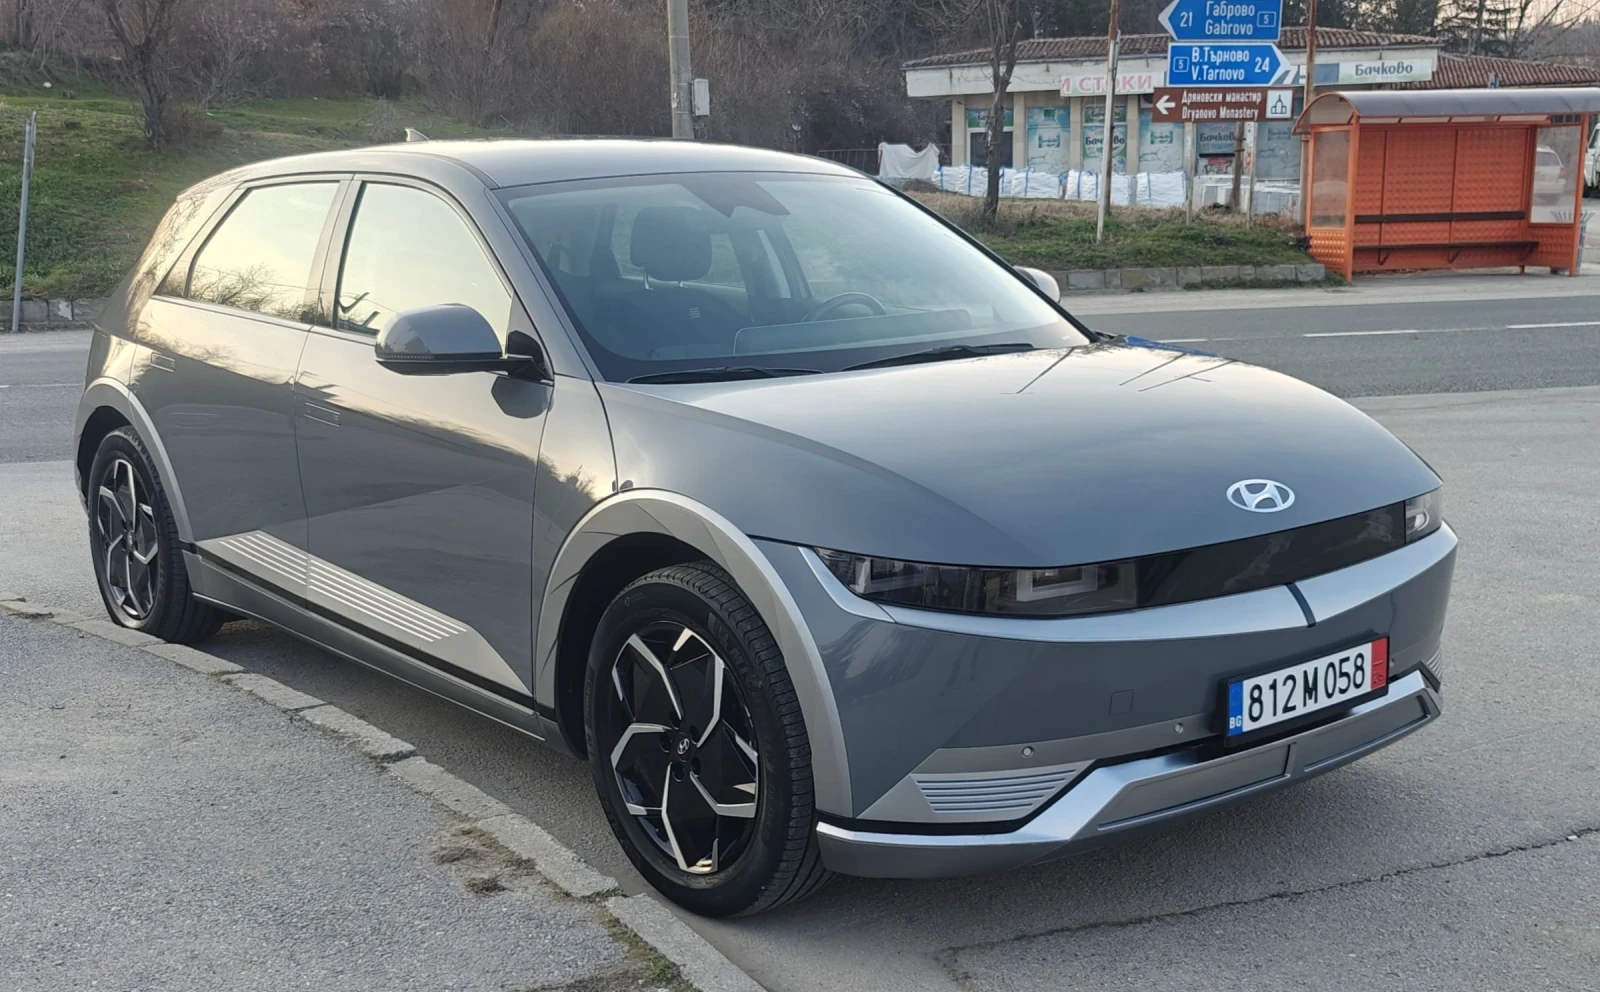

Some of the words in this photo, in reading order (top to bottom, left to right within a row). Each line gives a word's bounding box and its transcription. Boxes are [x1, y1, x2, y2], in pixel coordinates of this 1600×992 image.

[1206, 1, 1255, 19] Габрово
[1180, 11, 1193, 27] 21
[1263, 15, 1269, 24] 5
[1205, 19, 1253, 35] Gabrovo
[1191, 47, 1250, 65] В.Търново
[1178, 60, 1184, 69] 5
[1254, 57, 1270, 73] 24
[1355, 62, 1413, 76] Бачково
[1191, 65, 1245, 81] V.Tarnovo
[1181, 90, 1223, 104] Дряновски
[1225, 92, 1262, 105] манастир
[1181, 107, 1217, 121] Dryanovo
[1219, 106, 1259, 121] Monastery
[1085, 135, 1125, 146] Бачво
[1229, 715, 1242, 729] BG
